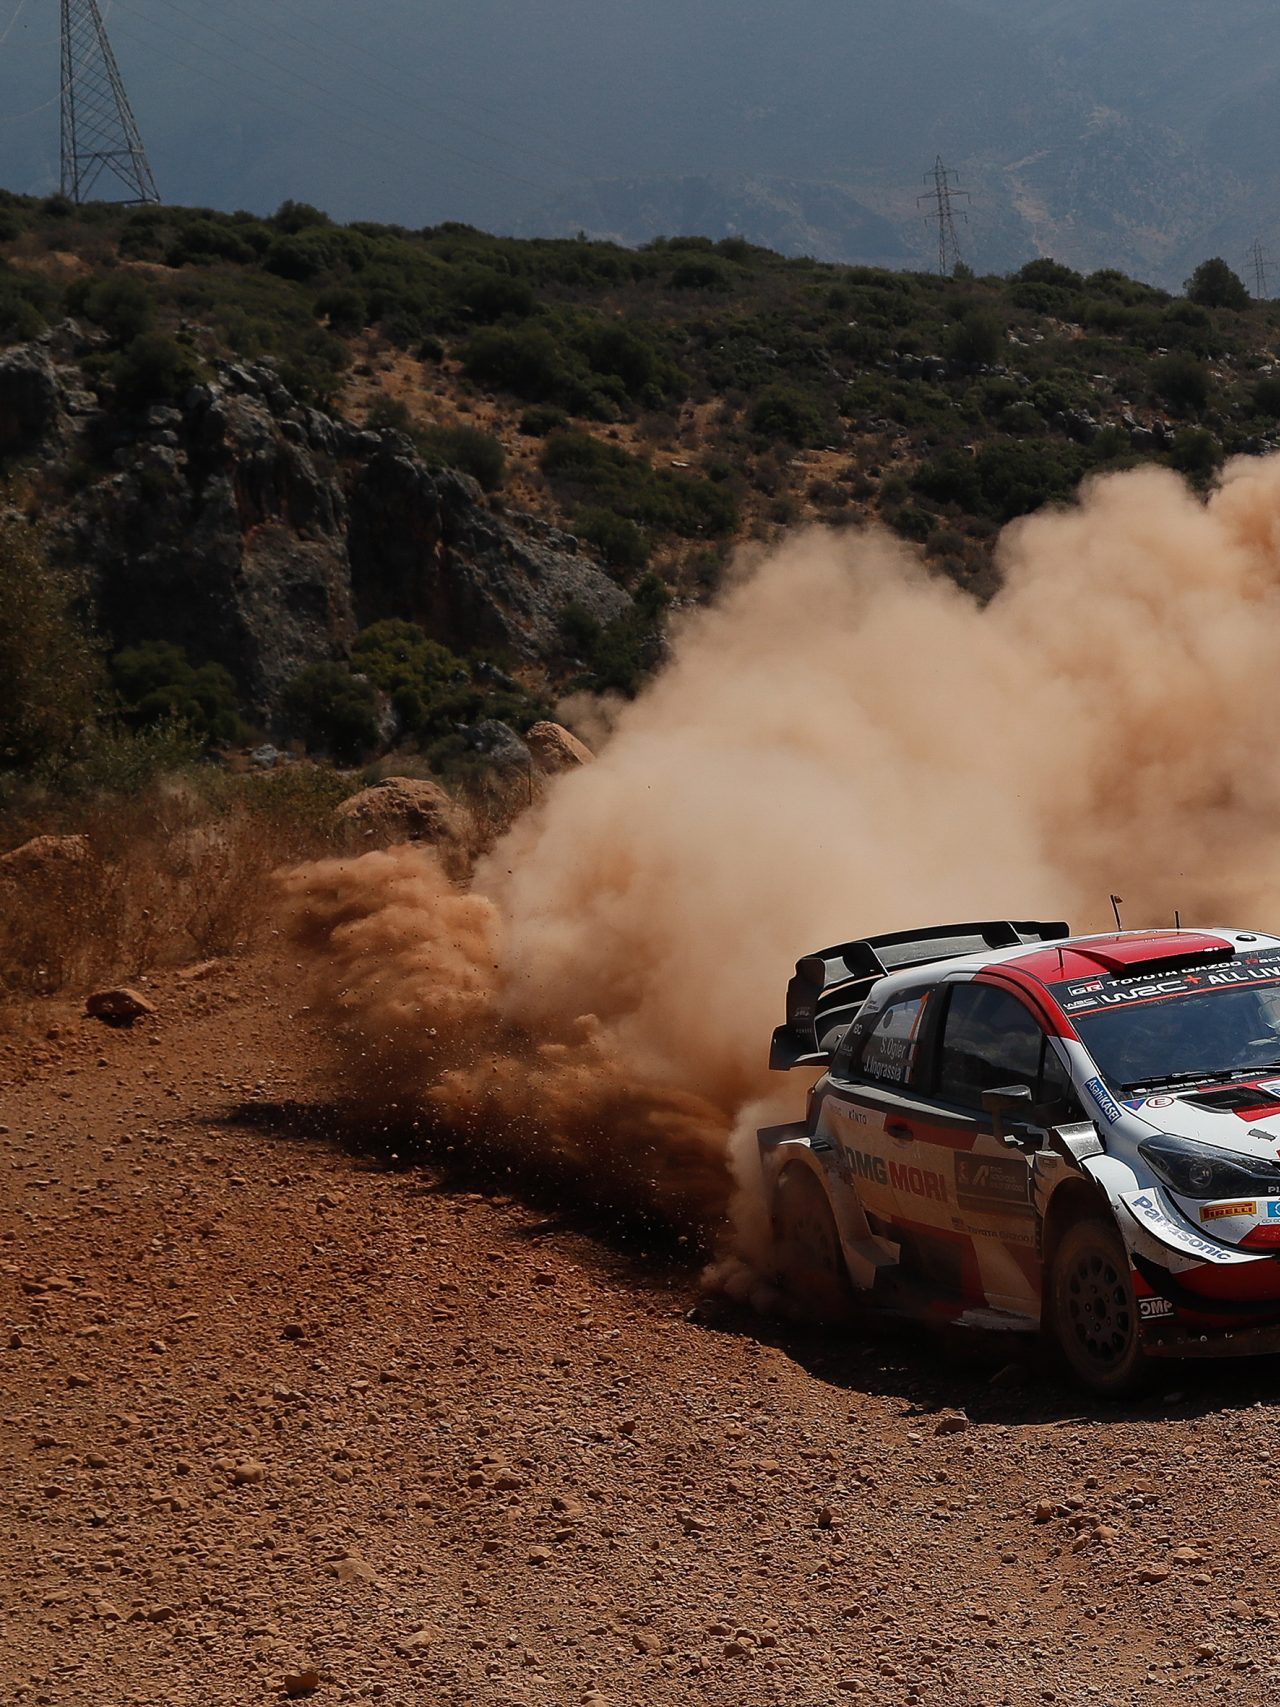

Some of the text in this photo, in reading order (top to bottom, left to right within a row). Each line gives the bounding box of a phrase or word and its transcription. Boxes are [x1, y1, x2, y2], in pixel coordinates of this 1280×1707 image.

[1071, 983, 1102, 996] GR
[1106, 970, 1178, 987] TOYOTA
[1181, 960, 1242, 974] GAZOO
[1208, 971, 1249, 985] ALL
[880, 1036, 907, 1059] S.Ogier
[843, 1146, 948, 1202] DMG MORI
[1203, 1203, 1253, 1219] PIRELLI
[1132, 1195, 1234, 1260] Panasonic
[1140, 1299, 1173, 1316] OMP
